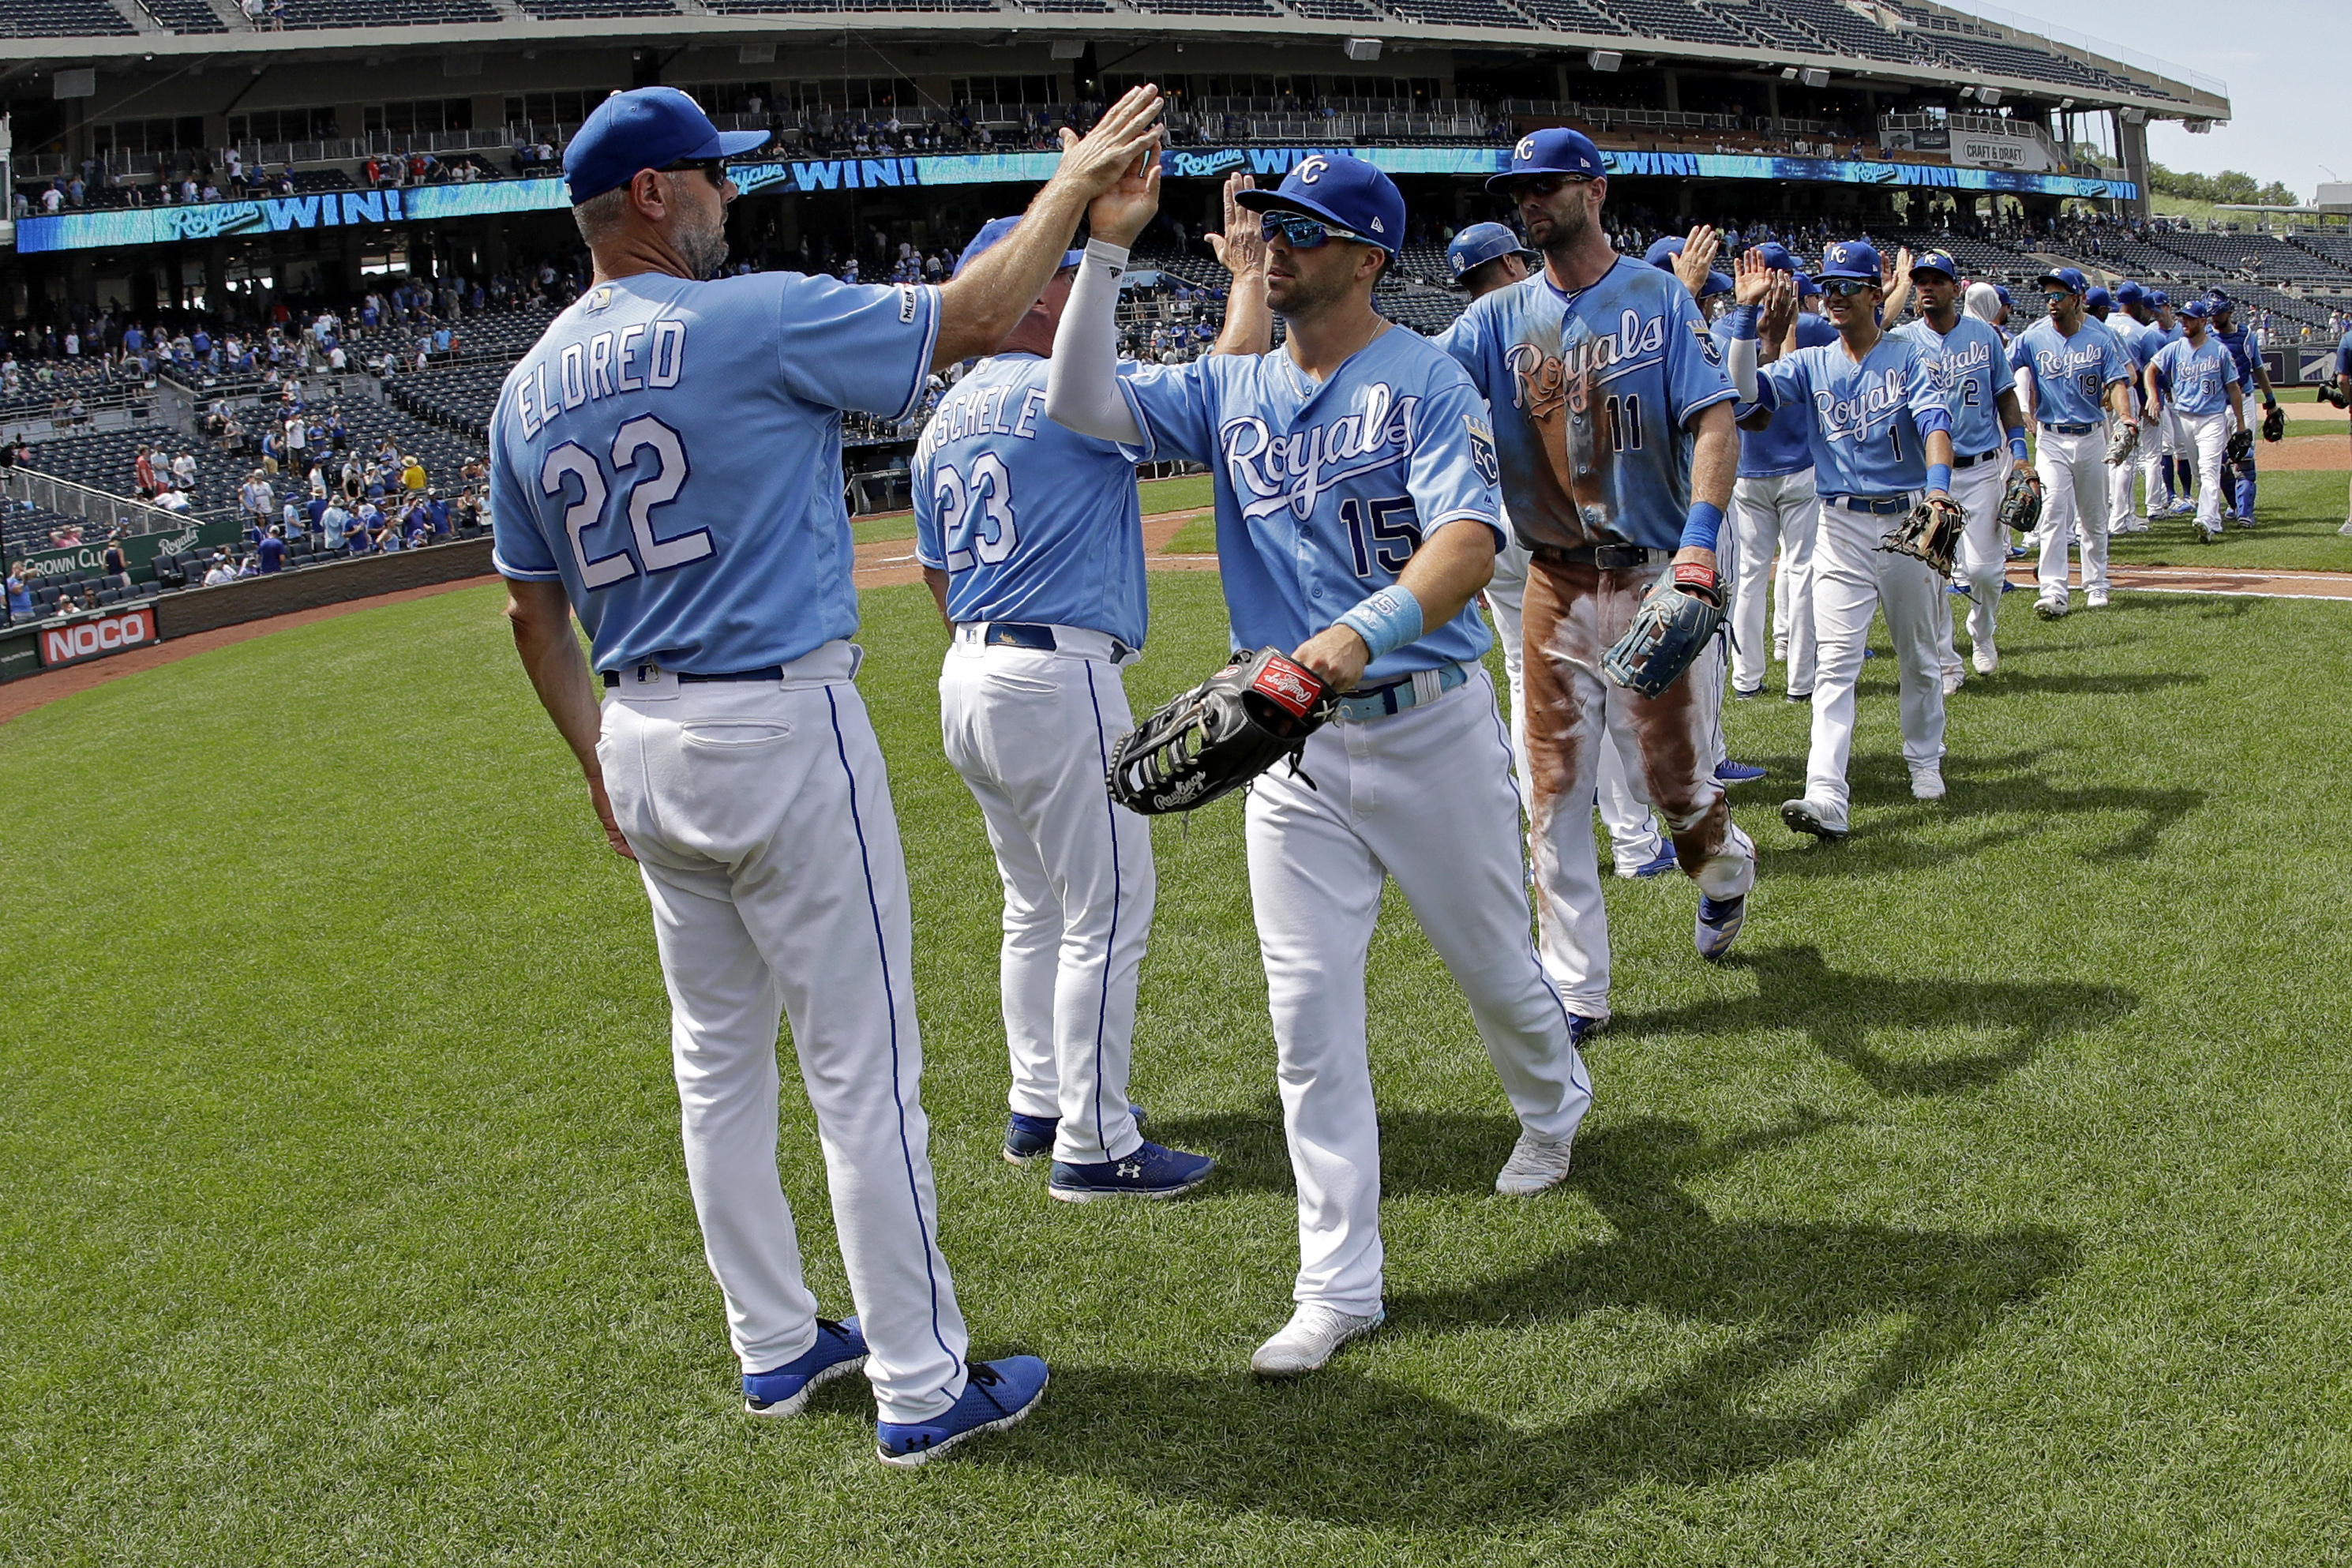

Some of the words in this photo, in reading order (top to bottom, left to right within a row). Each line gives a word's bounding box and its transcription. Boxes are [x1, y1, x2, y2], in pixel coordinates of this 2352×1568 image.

[1174, 148, 1245, 176] Royals
[1514, 137, 1536, 160] KC
[1617, 151, 1697, 175] WIN!
[1967, 144, 1990, 158] CRAFT
[1999, 148, 2022, 161] DRAFT
[791, 158, 917, 191] WIN!
[1292, 155, 1329, 184] KC
[1896, 164, 1958, 187] WIN!
[168, 199, 261, 238] Royals
[266, 189, 403, 231] WIN!
[1504, 308, 1665, 419] Royals
[2035, 343, 2103, 380] Royals
[2176, 354, 2221, 381] Royals
[516, 319, 687, 442] ELDRED
[1963, 377, 1980, 407] 2
[2077, 373, 2099, 396] 19
[2200, 380, 2218, 396] 31
[1814, 366, 1907, 443] Royals
[1605, 393, 1642, 452] 11
[1220, 382, 1422, 521] Royals
[1470, 437, 1498, 481] KC
[1888, 423, 1904, 463] 1
[539, 411, 718, 592] 22
[934, 451, 1020, 574] 23
[158, 526, 200, 557] Royals
[1338, 496, 1422, 578] 15
[78, 548, 107, 569] CLU
[48, 613, 145, 662] NOCO
[1263, 672, 1312, 703] Rawlings
[1153, 771, 1206, 810] Rawlings
